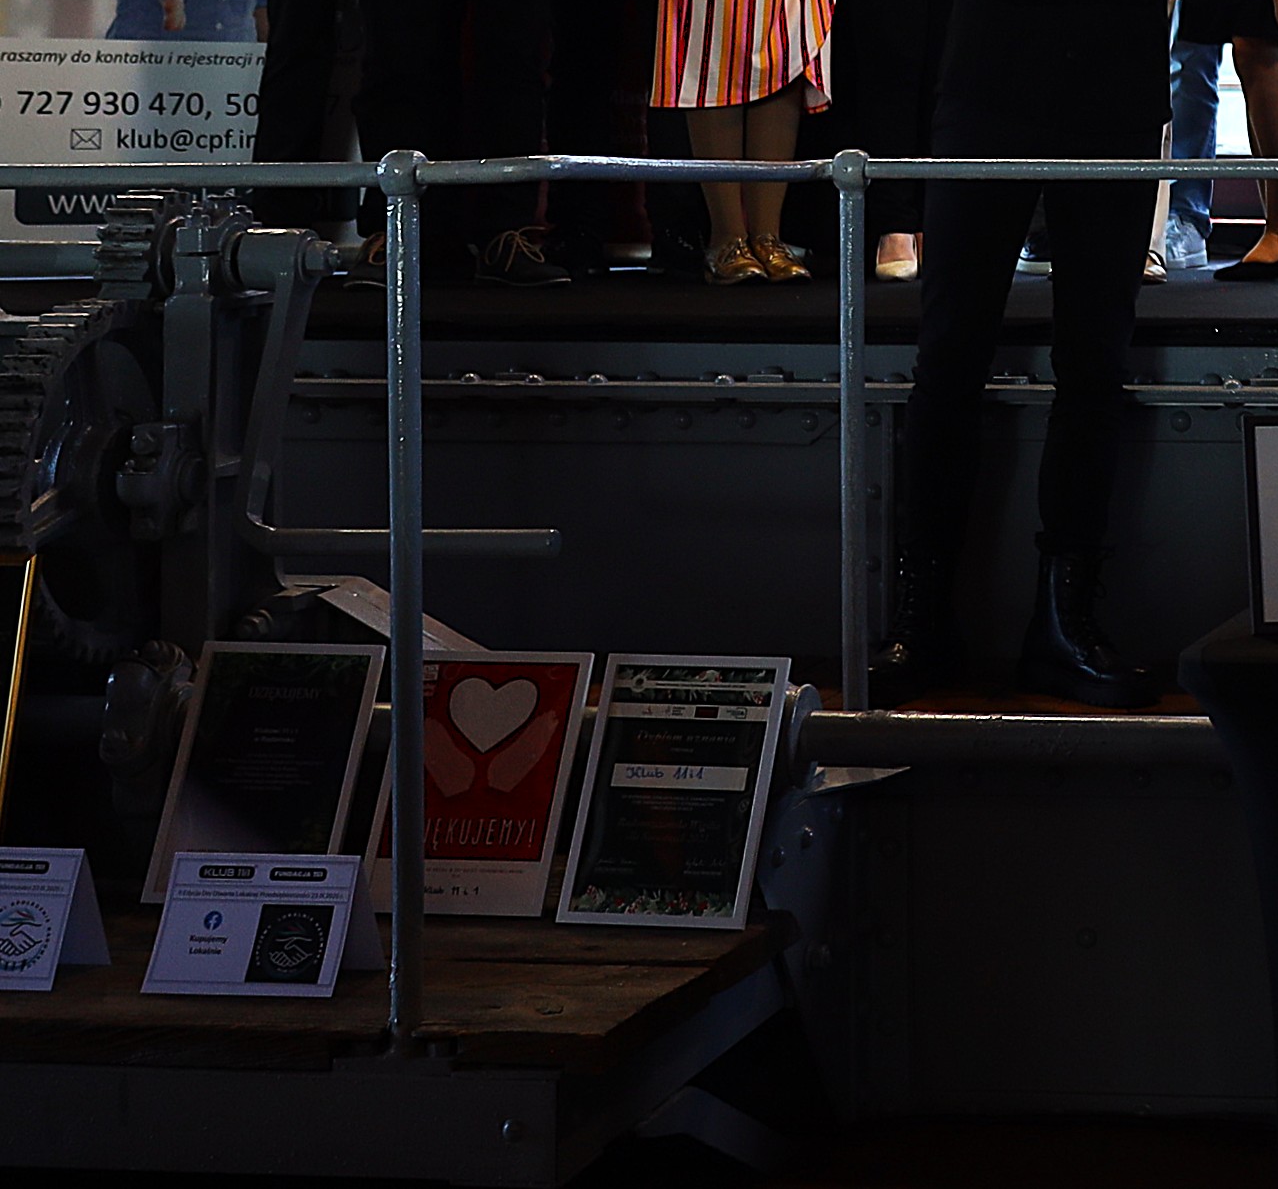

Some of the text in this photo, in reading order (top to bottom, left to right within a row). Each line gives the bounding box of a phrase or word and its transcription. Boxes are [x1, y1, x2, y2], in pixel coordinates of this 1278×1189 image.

[0, 49, 254, 69] raszamy do kontaktu i rejestracji
[17, 90, 261, 120] 727 930 470, 50
